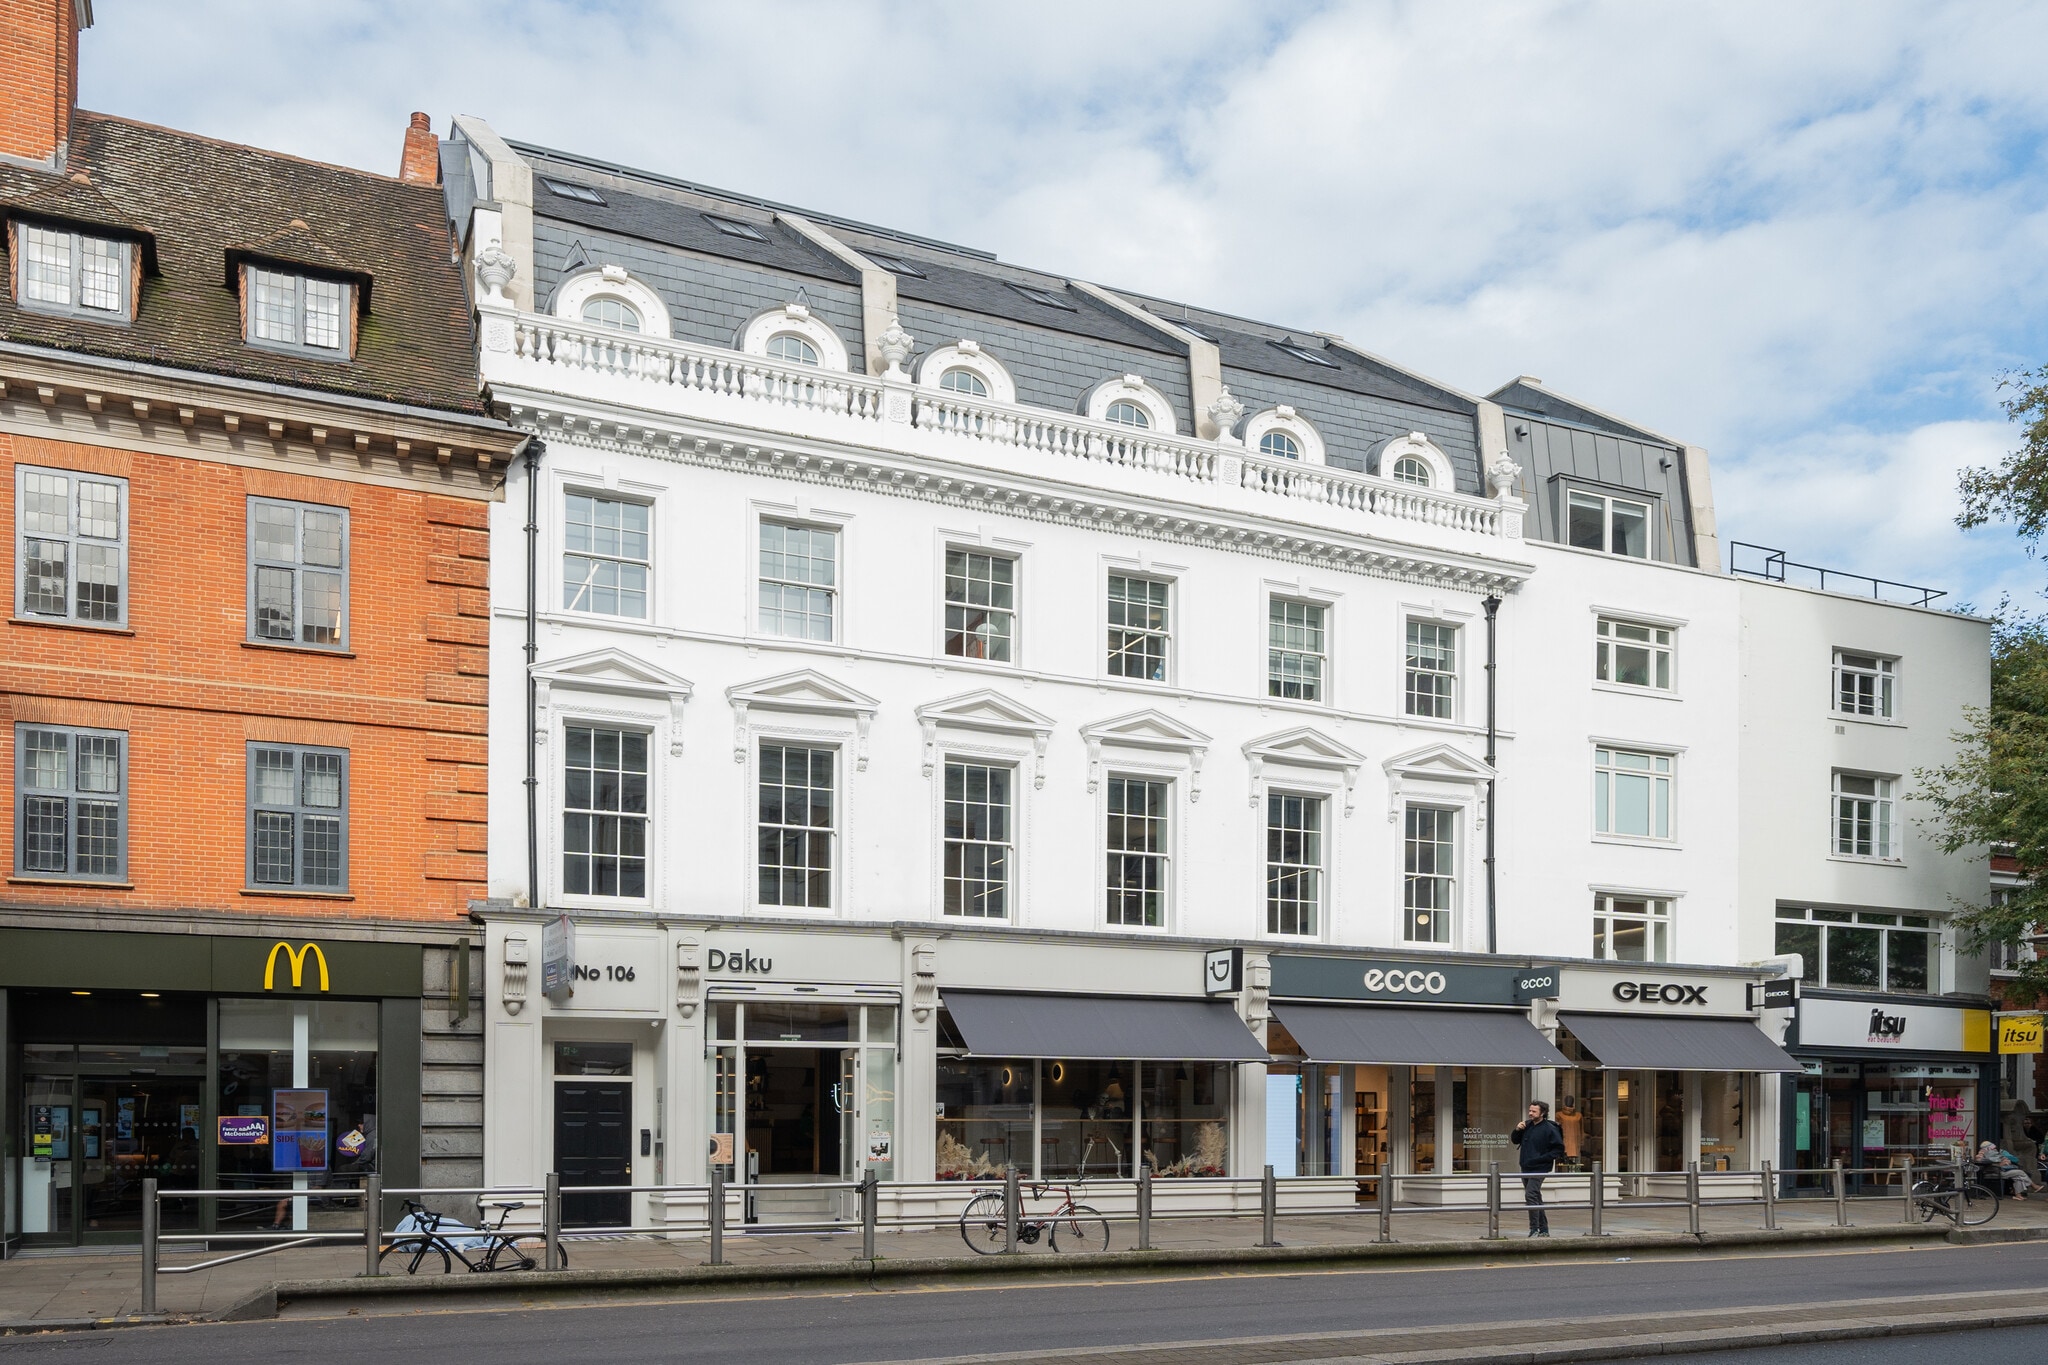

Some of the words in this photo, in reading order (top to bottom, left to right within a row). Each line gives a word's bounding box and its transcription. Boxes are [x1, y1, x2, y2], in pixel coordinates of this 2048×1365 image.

[708, 949, 772, 973] Dāku
[575, 965, 600, 980] No
[607, 966, 635, 982] 106
[1364, 968, 1446, 995] ecco
[1521, 976, 1552, 990] ecco
[1612, 981, 1708, 1004] GEOX
[1765, 990, 1790, 998] GEOX
[1869, 1008, 1906, 1035] itsu
[2004, 1028, 2037, 1042] itsu
[1900, 1065, 1918, 1073] bao
[1928, 1094, 1964, 1109] friends
[276, 1135, 295, 1143] SIDE
[1928, 1124, 1964, 1139] benefits
